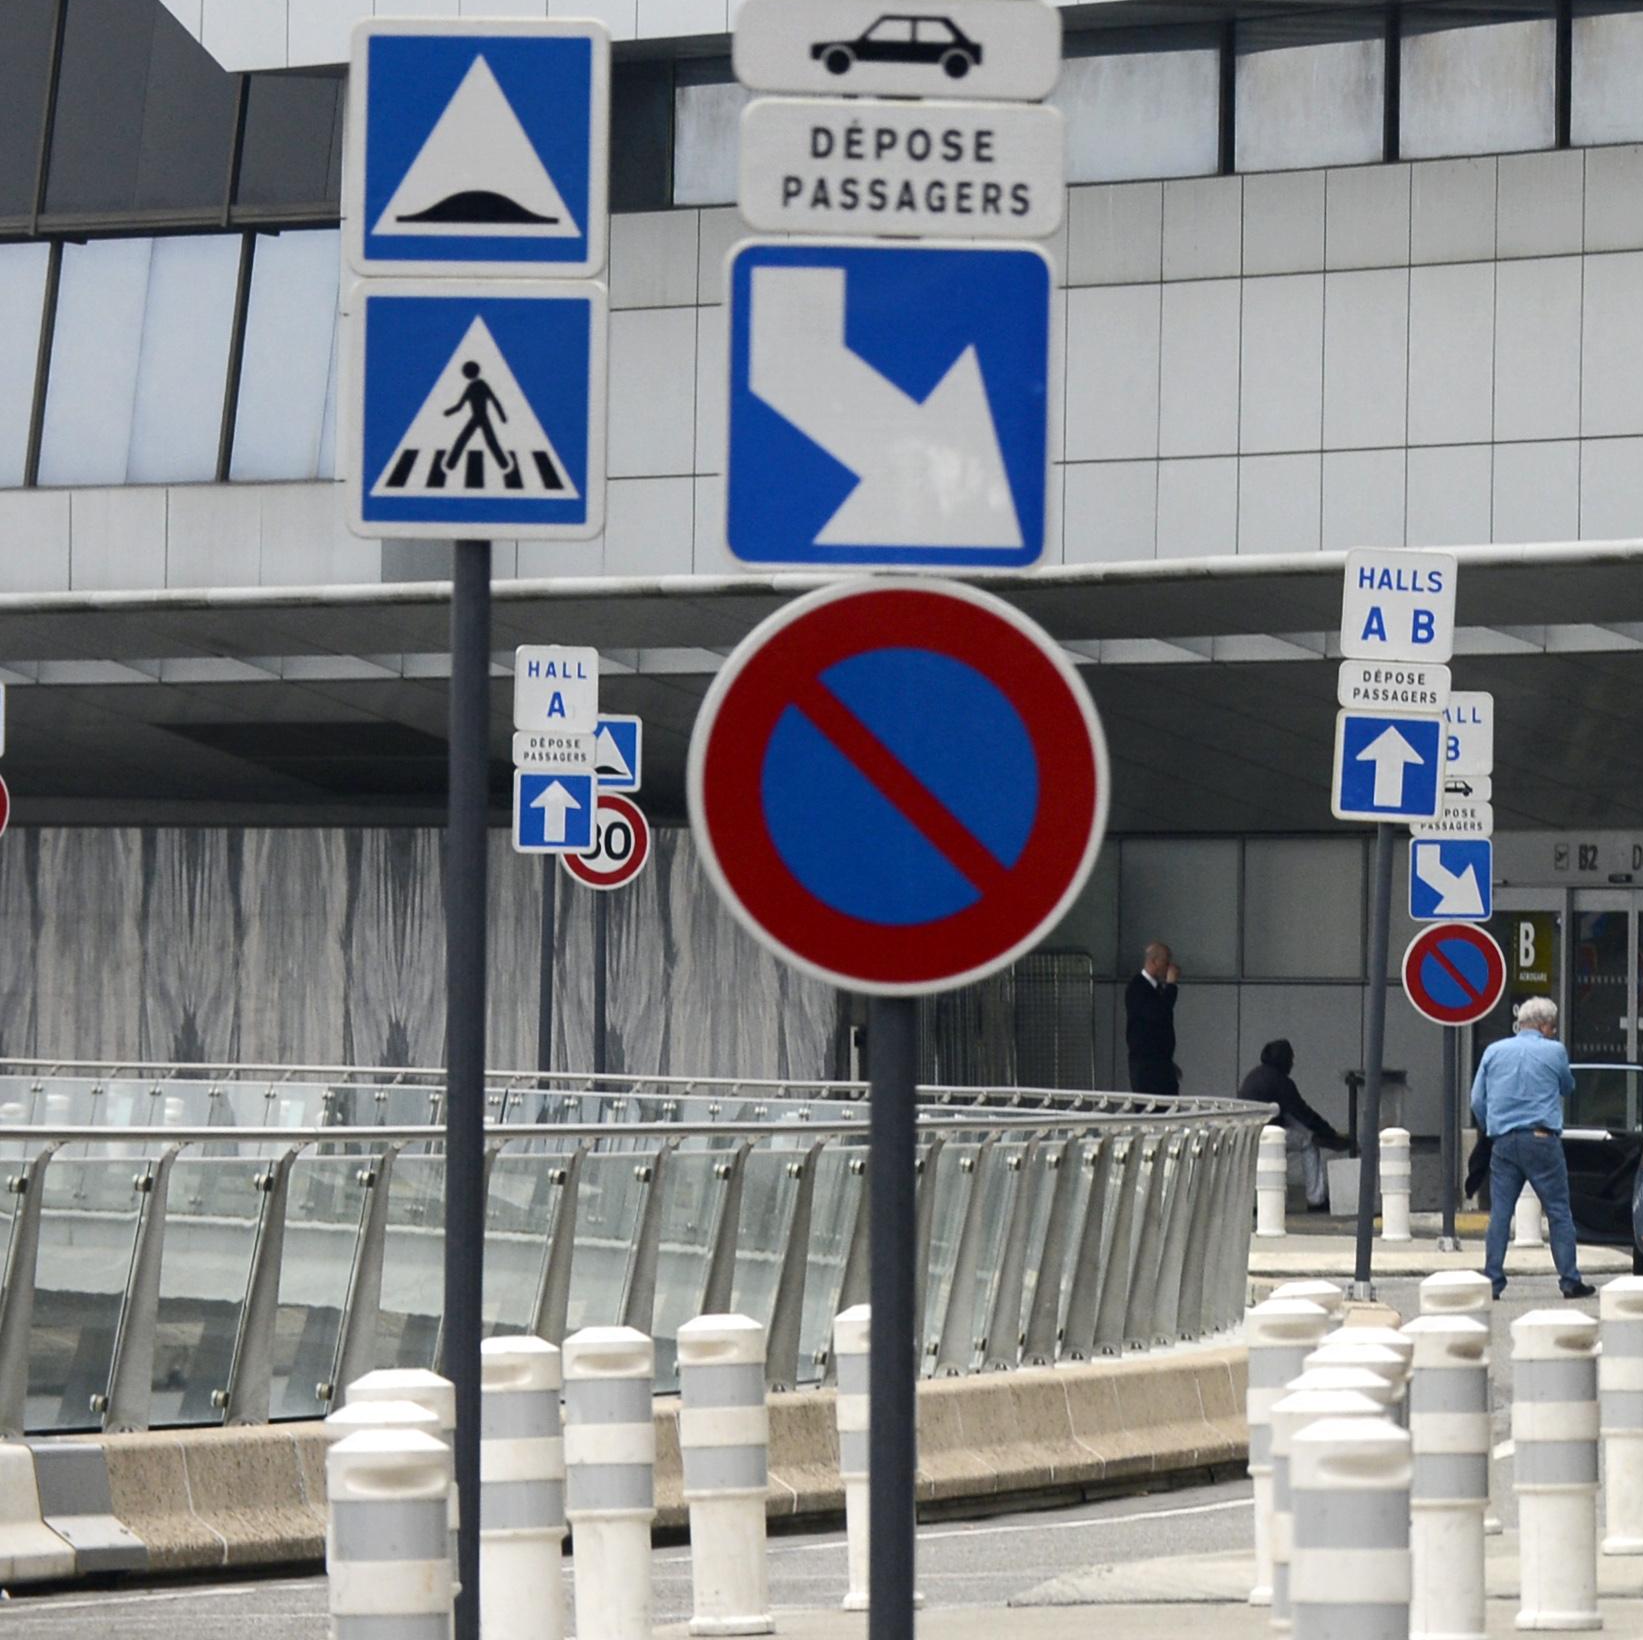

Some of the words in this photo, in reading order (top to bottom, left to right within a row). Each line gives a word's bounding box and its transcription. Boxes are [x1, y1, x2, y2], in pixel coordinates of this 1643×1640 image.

[809, 118, 997, 164] DÉPOSE
[781, 175, 1032, 217] PASSAGERS
[1358, 565, 1444, 593] HALLS
[1361, 606, 1388, 642] A
[1411, 608, 1436, 644] B
[527, 660, 588, 679] HALL
[1362, 668, 1426, 686] DÉPOSE
[546, 690, 566, 718] A
[1352, 687, 1438, 704] PASSAGERS
[529, 736, 582, 749] DÉPOSE
[1446, 735, 1461, 762] B
[523, 751, 587, 763] PASSAGERS
[1420, 821, 1484, 831] PASSAGERS
[1519, 921, 1536, 968] B
